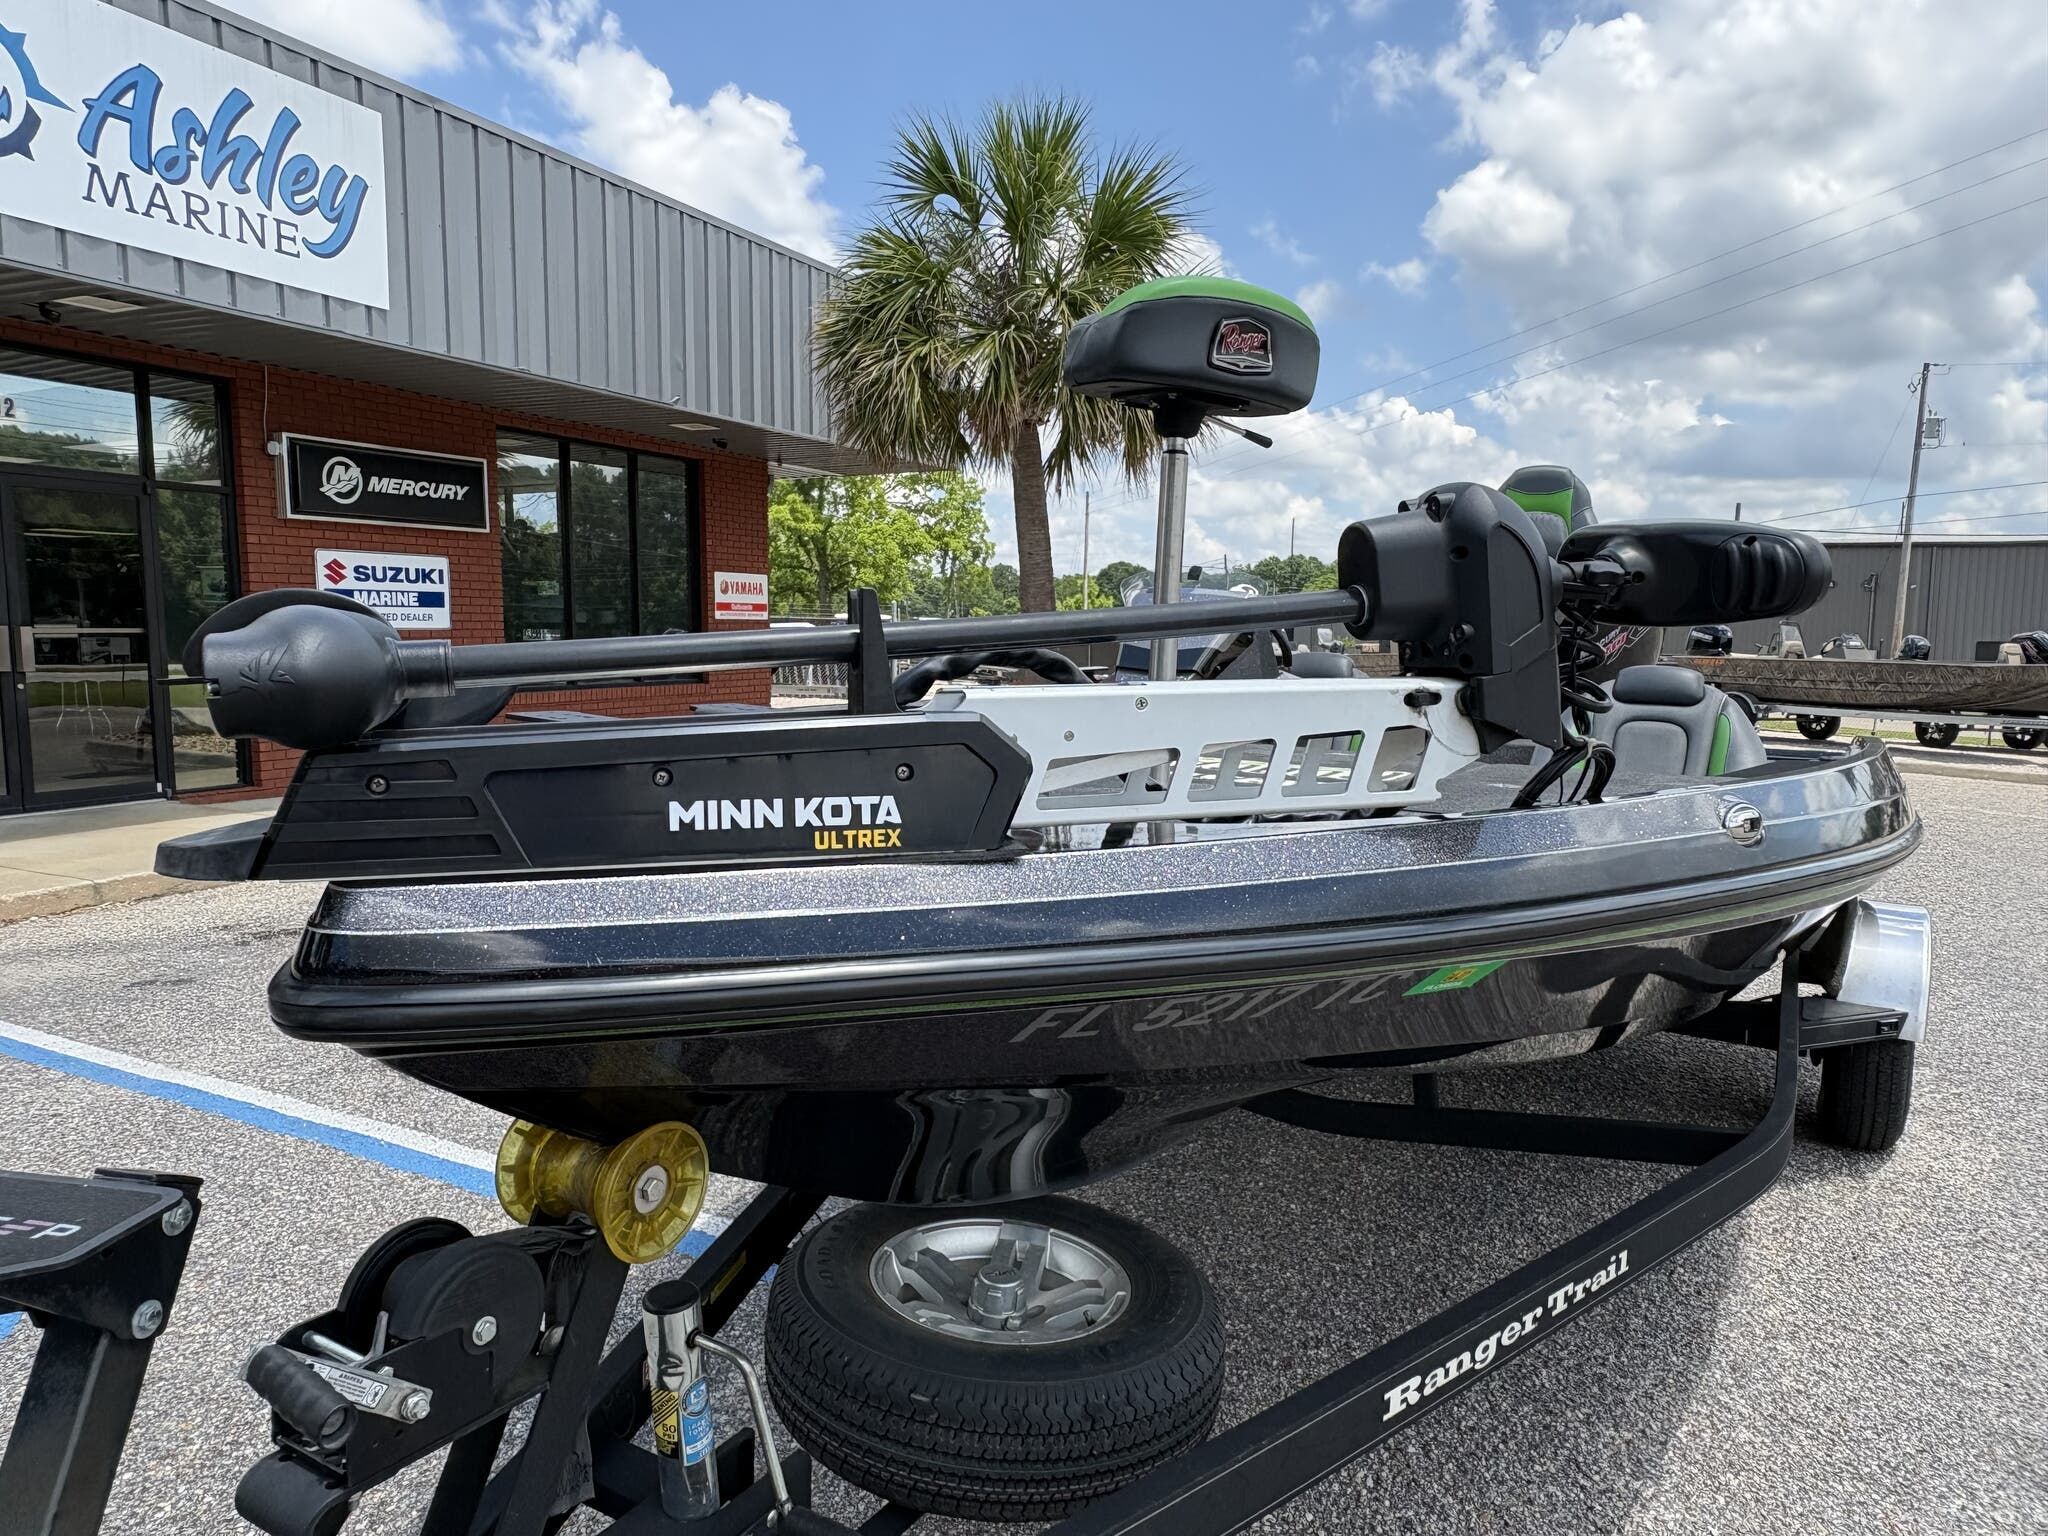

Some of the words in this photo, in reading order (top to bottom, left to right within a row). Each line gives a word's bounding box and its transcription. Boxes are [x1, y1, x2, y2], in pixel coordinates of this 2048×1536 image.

[77, 63, 369, 259] Ashley
[82, 163, 301, 258] MARINE
[367, 476, 470, 501] MERCURY
[353, 565, 445, 585] SUZUKI
[353, 590, 419, 607] MARINE
[730, 581, 764, 596] YAMAHA
[400, 614, 434, 622] DEALER
[668, 798, 784, 831] MINN
[794, 795, 902, 828] KOTA
[814, 828, 902, 850] ULTREX
[1009, 1004, 1114, 1043] FL
[1382, 1305, 1544, 1422] Ranger
[1547, 1249, 1630, 1318] Trail
[662, 1423, 676, 1433] 50
